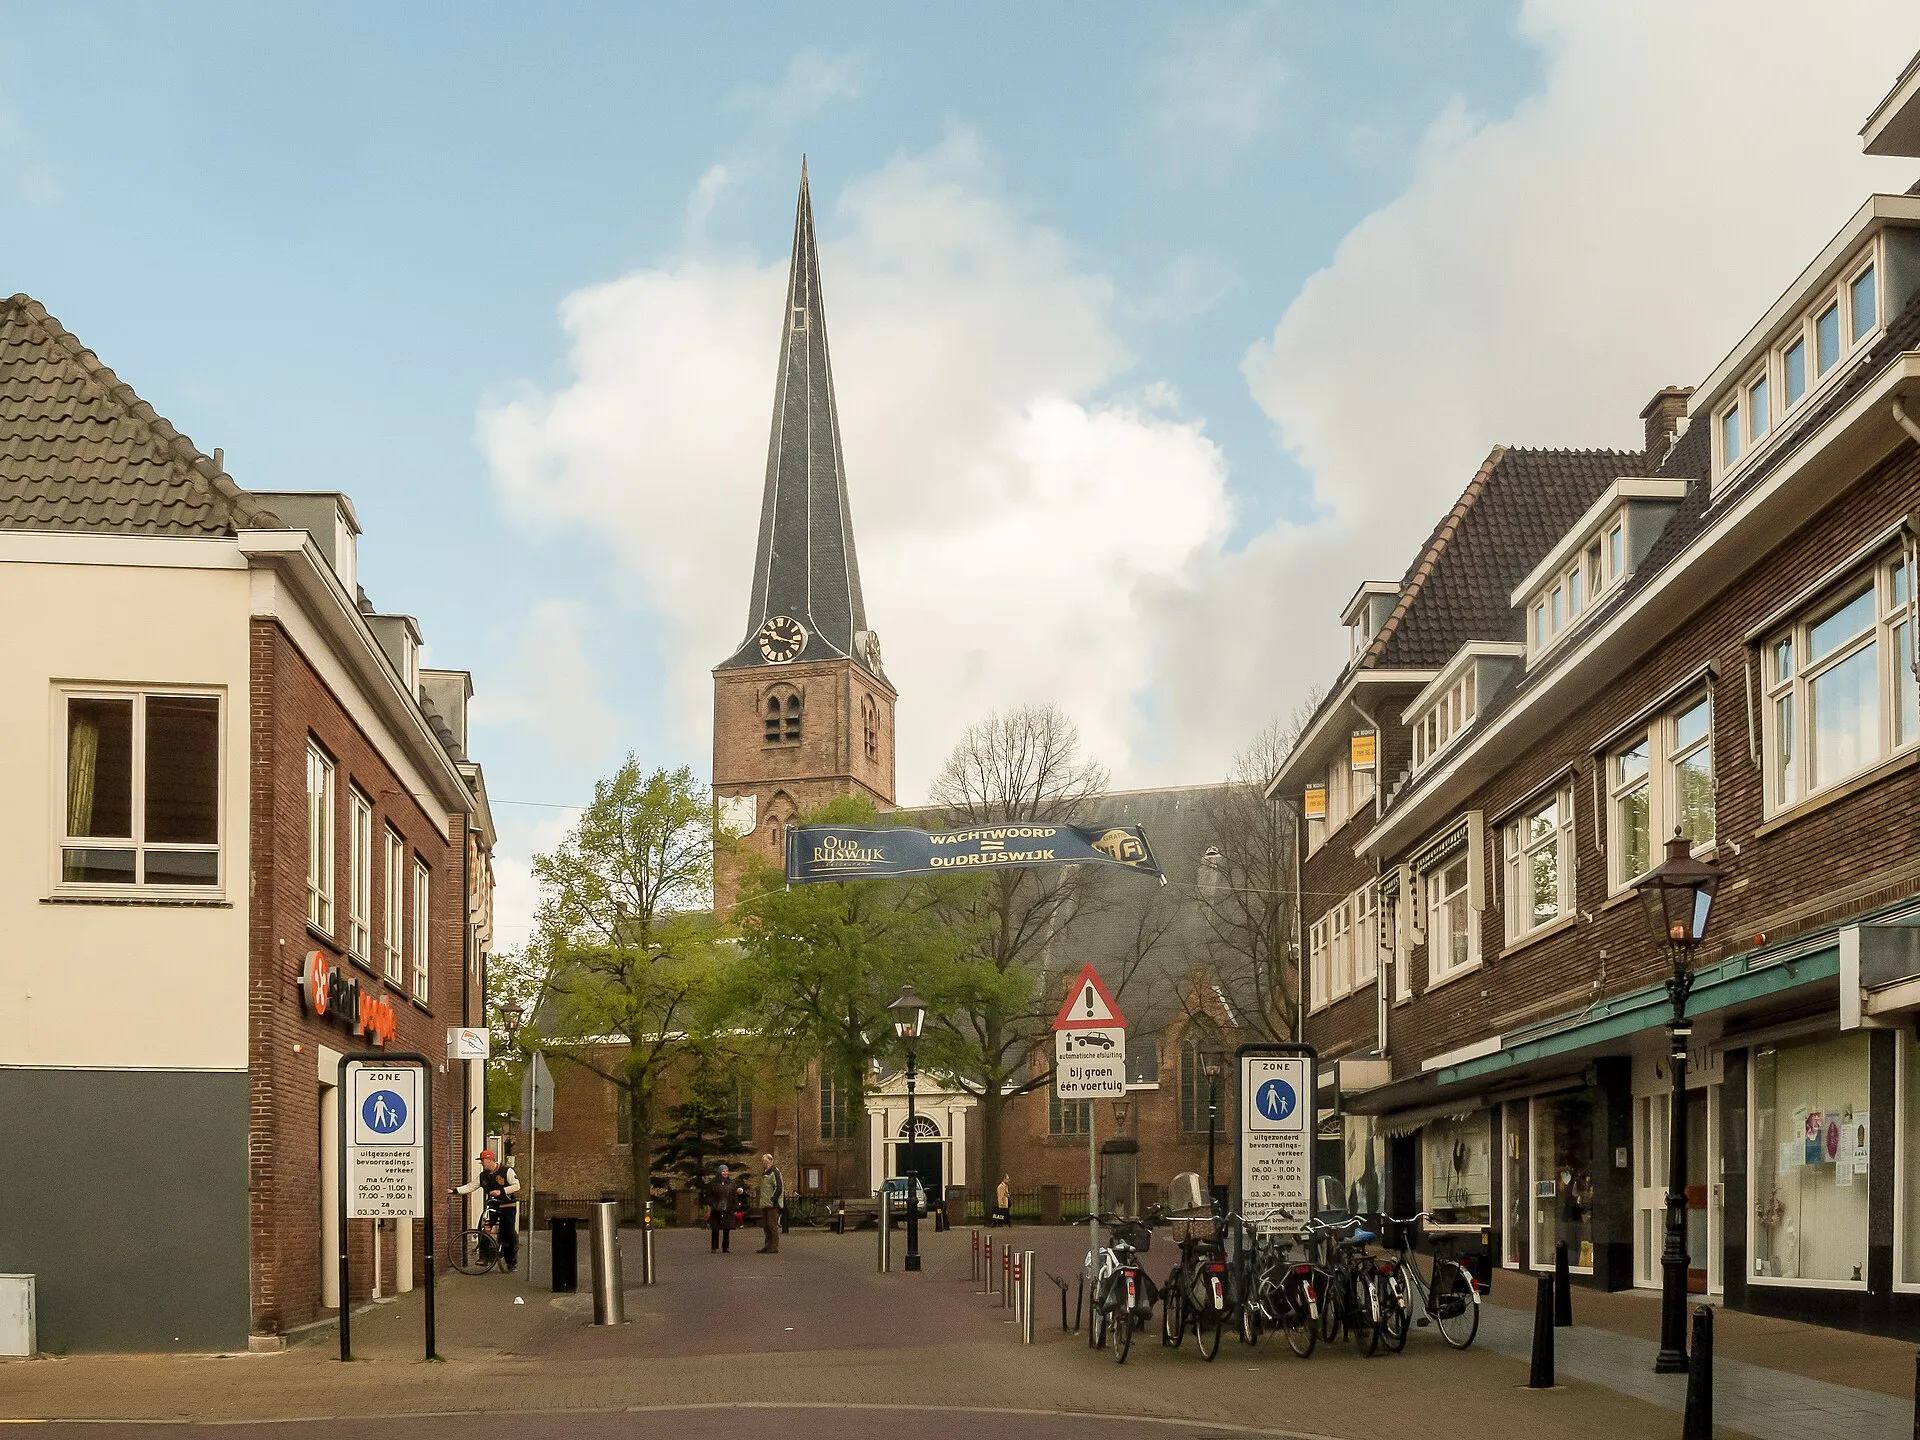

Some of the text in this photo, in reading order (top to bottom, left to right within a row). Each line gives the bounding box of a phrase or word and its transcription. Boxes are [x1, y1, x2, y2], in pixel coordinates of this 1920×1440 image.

[823, 835, 858, 850] OUD
[930, 828, 1056, 845] WACHTWOORD
[813, 847, 884, 864] RIJSWIJK
[930, 849, 1055, 867] OUDRIJSWIJK
[370, 1073, 400, 1081] ZONE
[1070, 1067, 1112, 1080] bij groen
[1061, 1080, 1122, 1092] één voertuig
